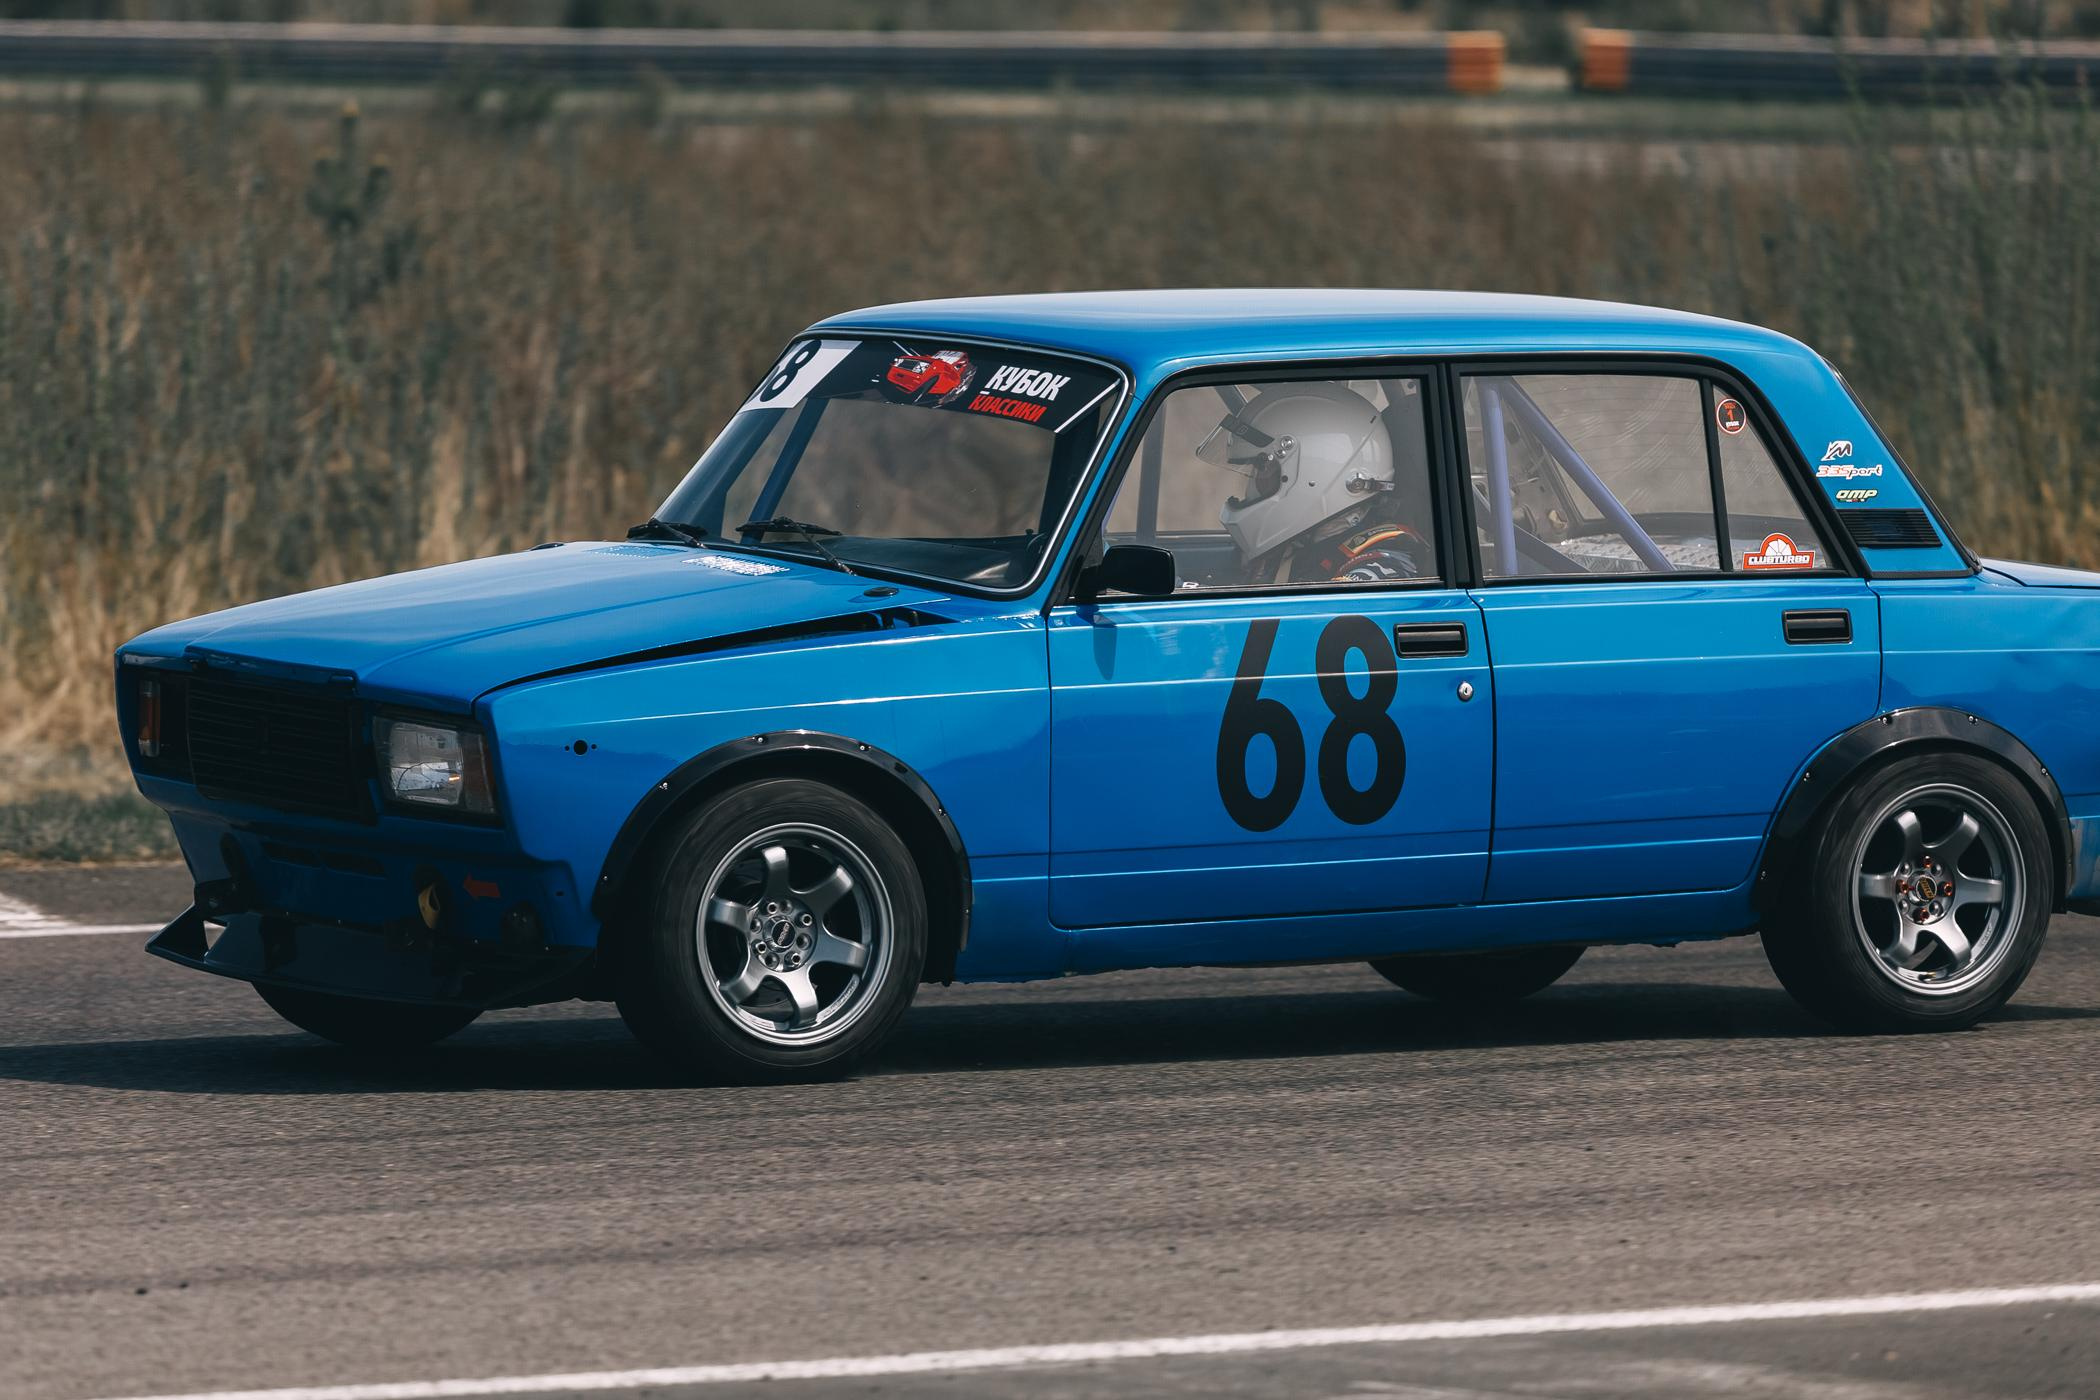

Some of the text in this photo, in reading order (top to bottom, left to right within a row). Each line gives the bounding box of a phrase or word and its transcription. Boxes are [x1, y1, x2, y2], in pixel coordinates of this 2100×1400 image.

[750, 339, 823, 403] 8
[983, 365, 1072, 401] КУБОК
[966, 393, 1048, 423] КЛАССИКИ
[1217, 615, 1406, 832] 68
